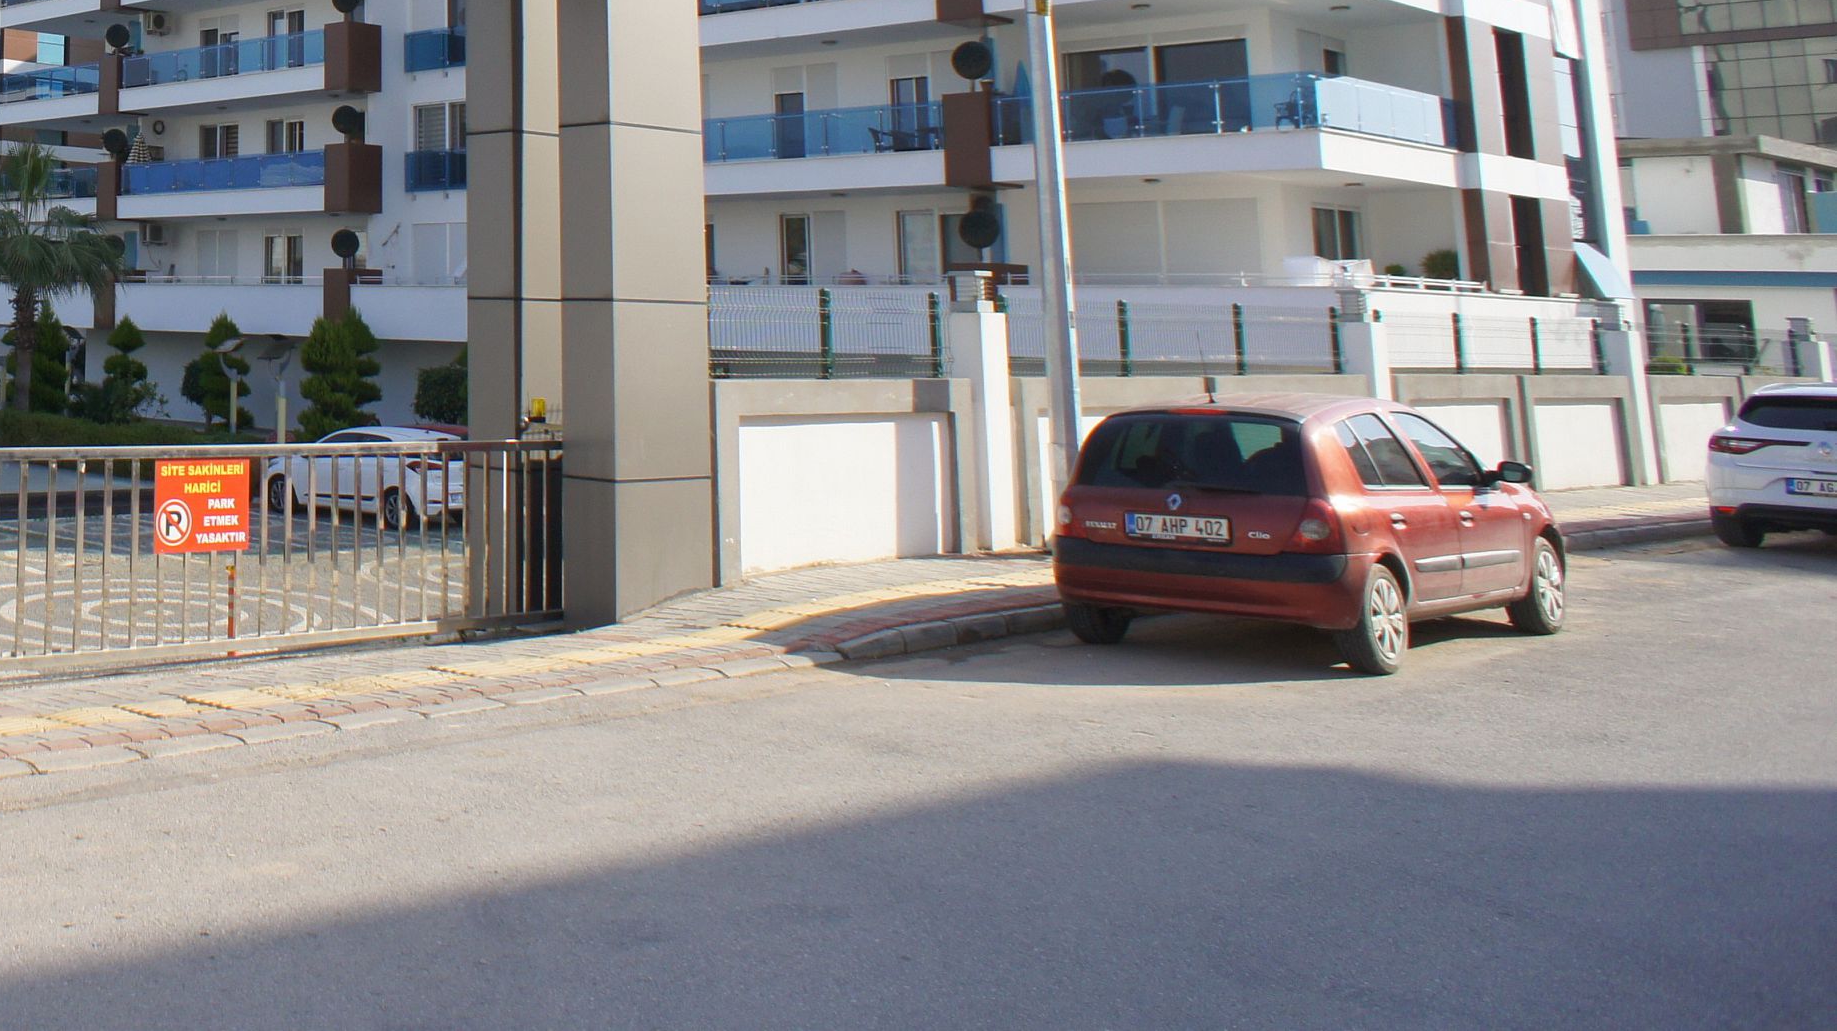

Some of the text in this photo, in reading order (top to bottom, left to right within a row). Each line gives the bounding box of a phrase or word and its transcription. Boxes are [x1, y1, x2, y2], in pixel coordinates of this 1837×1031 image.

[161, 462, 244, 476] SİTE SAKİNLERİ
[184, 480, 221, 494] HARİCİ
[1796, 481, 1837, 492] 07 AG
[208, 498, 235, 509] PARK
[203, 515, 239, 526] ETMEK
[1135, 516, 1223, 536] 07 AHP 402
[195, 532, 246, 544] YASAKTIR
[1248, 531, 1271, 539] Clio
